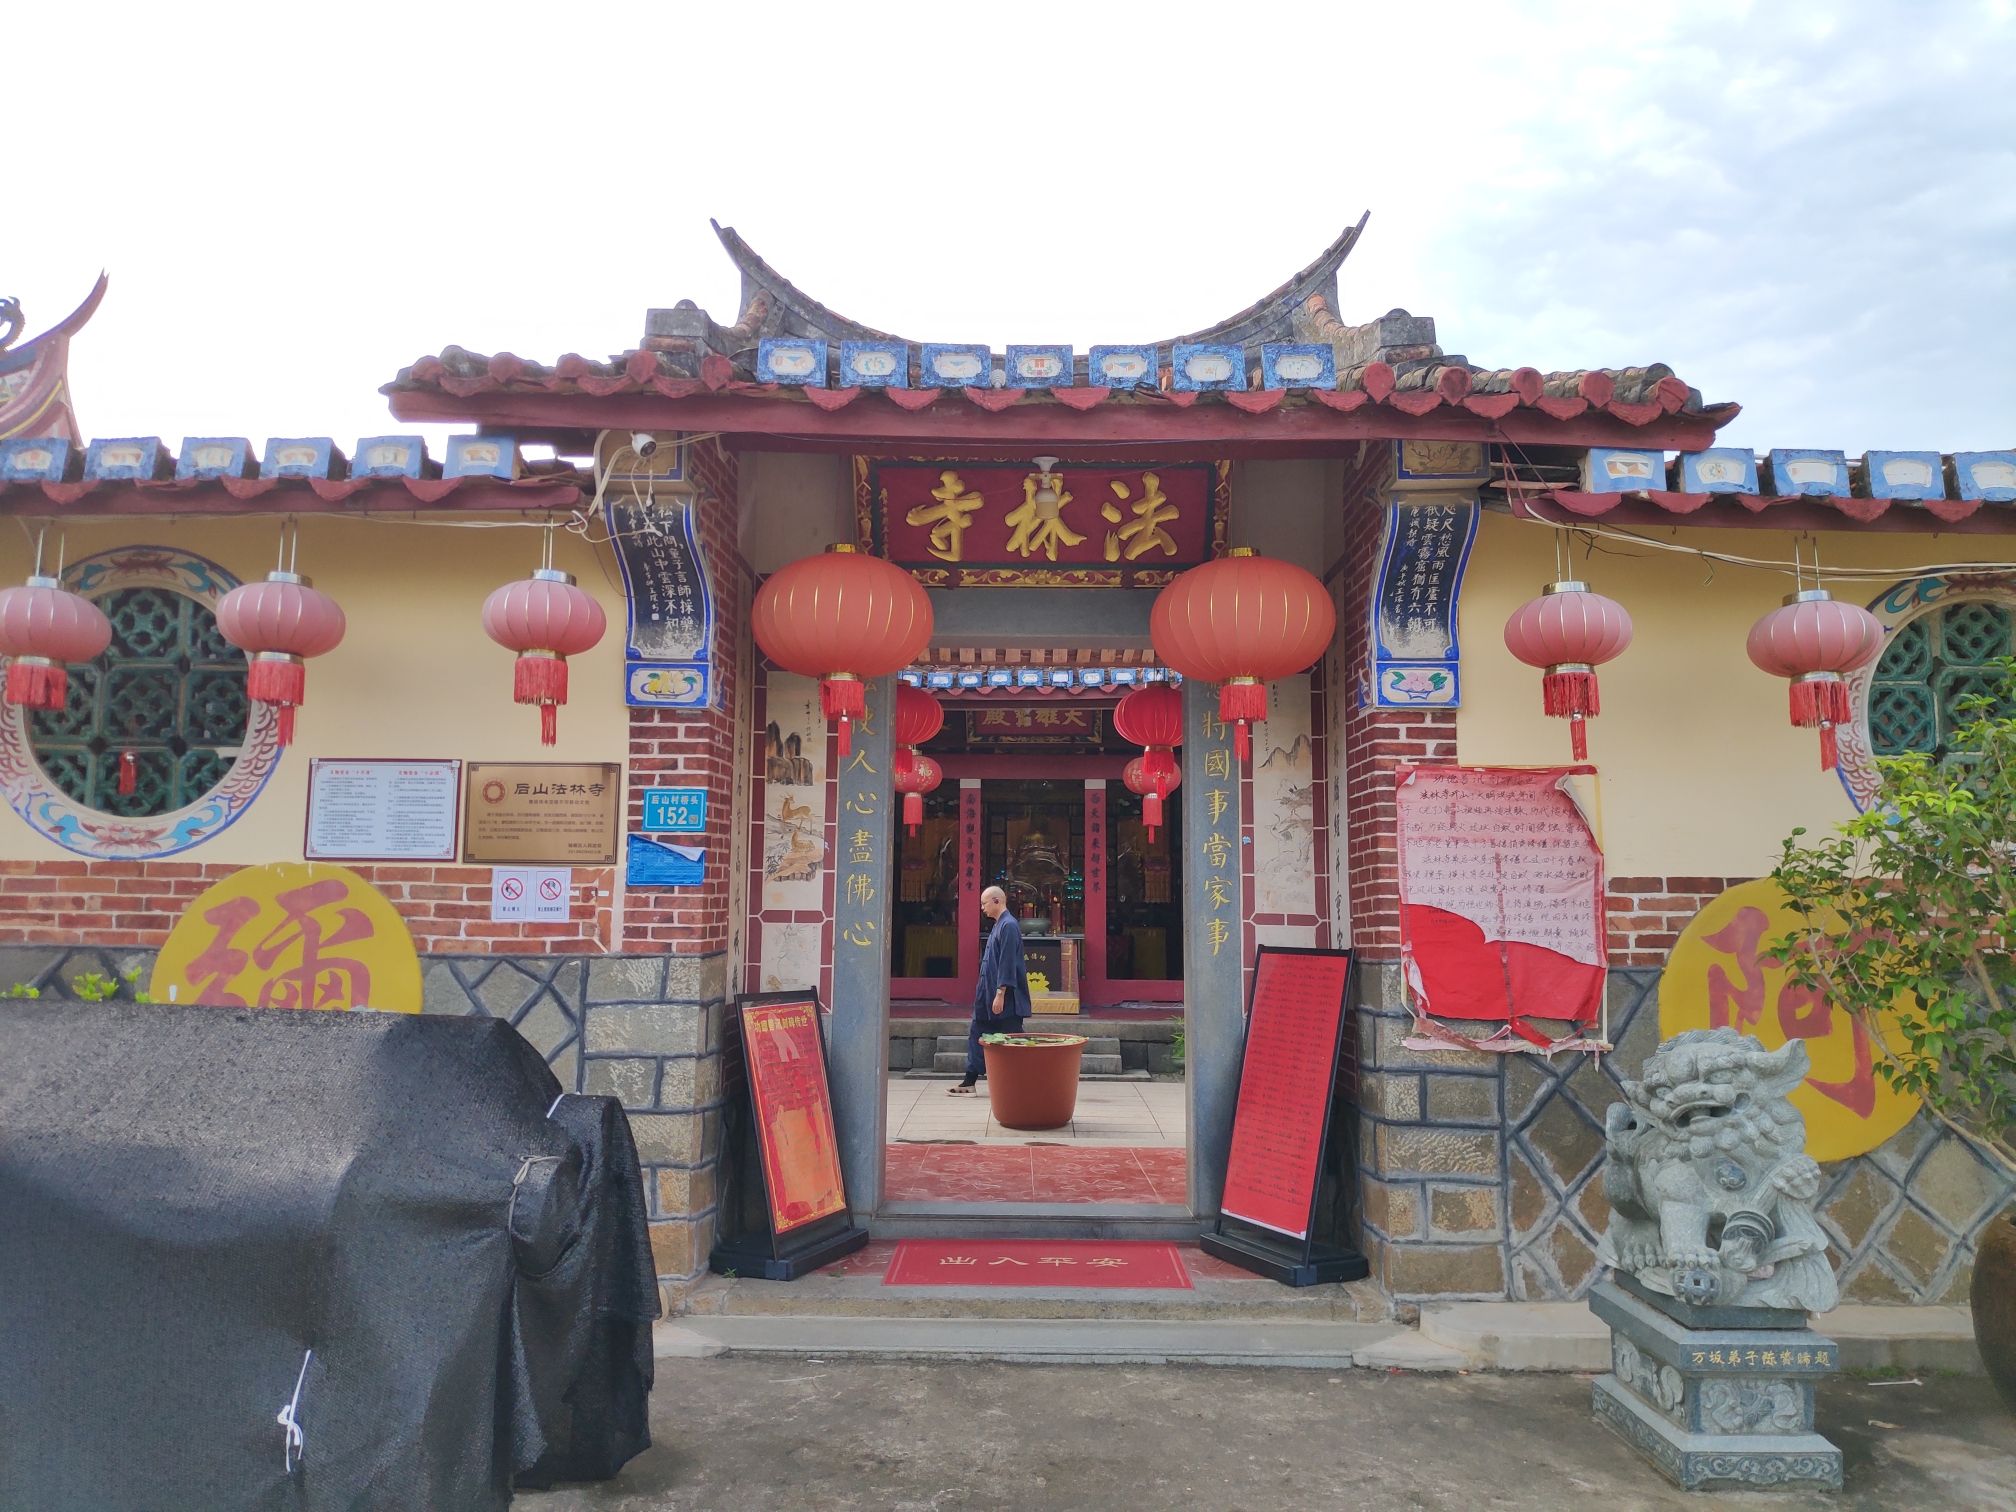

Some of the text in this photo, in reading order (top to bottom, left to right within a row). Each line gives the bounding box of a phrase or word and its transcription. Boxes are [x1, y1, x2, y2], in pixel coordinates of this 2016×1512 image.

[513, 783, 606, 797] 后山法林寺
[657, 806, 687, 825] 152
[844, 681, 878, 947] 使人心盡佛心
[939, 1256, 1129, 1268] 出入平安
